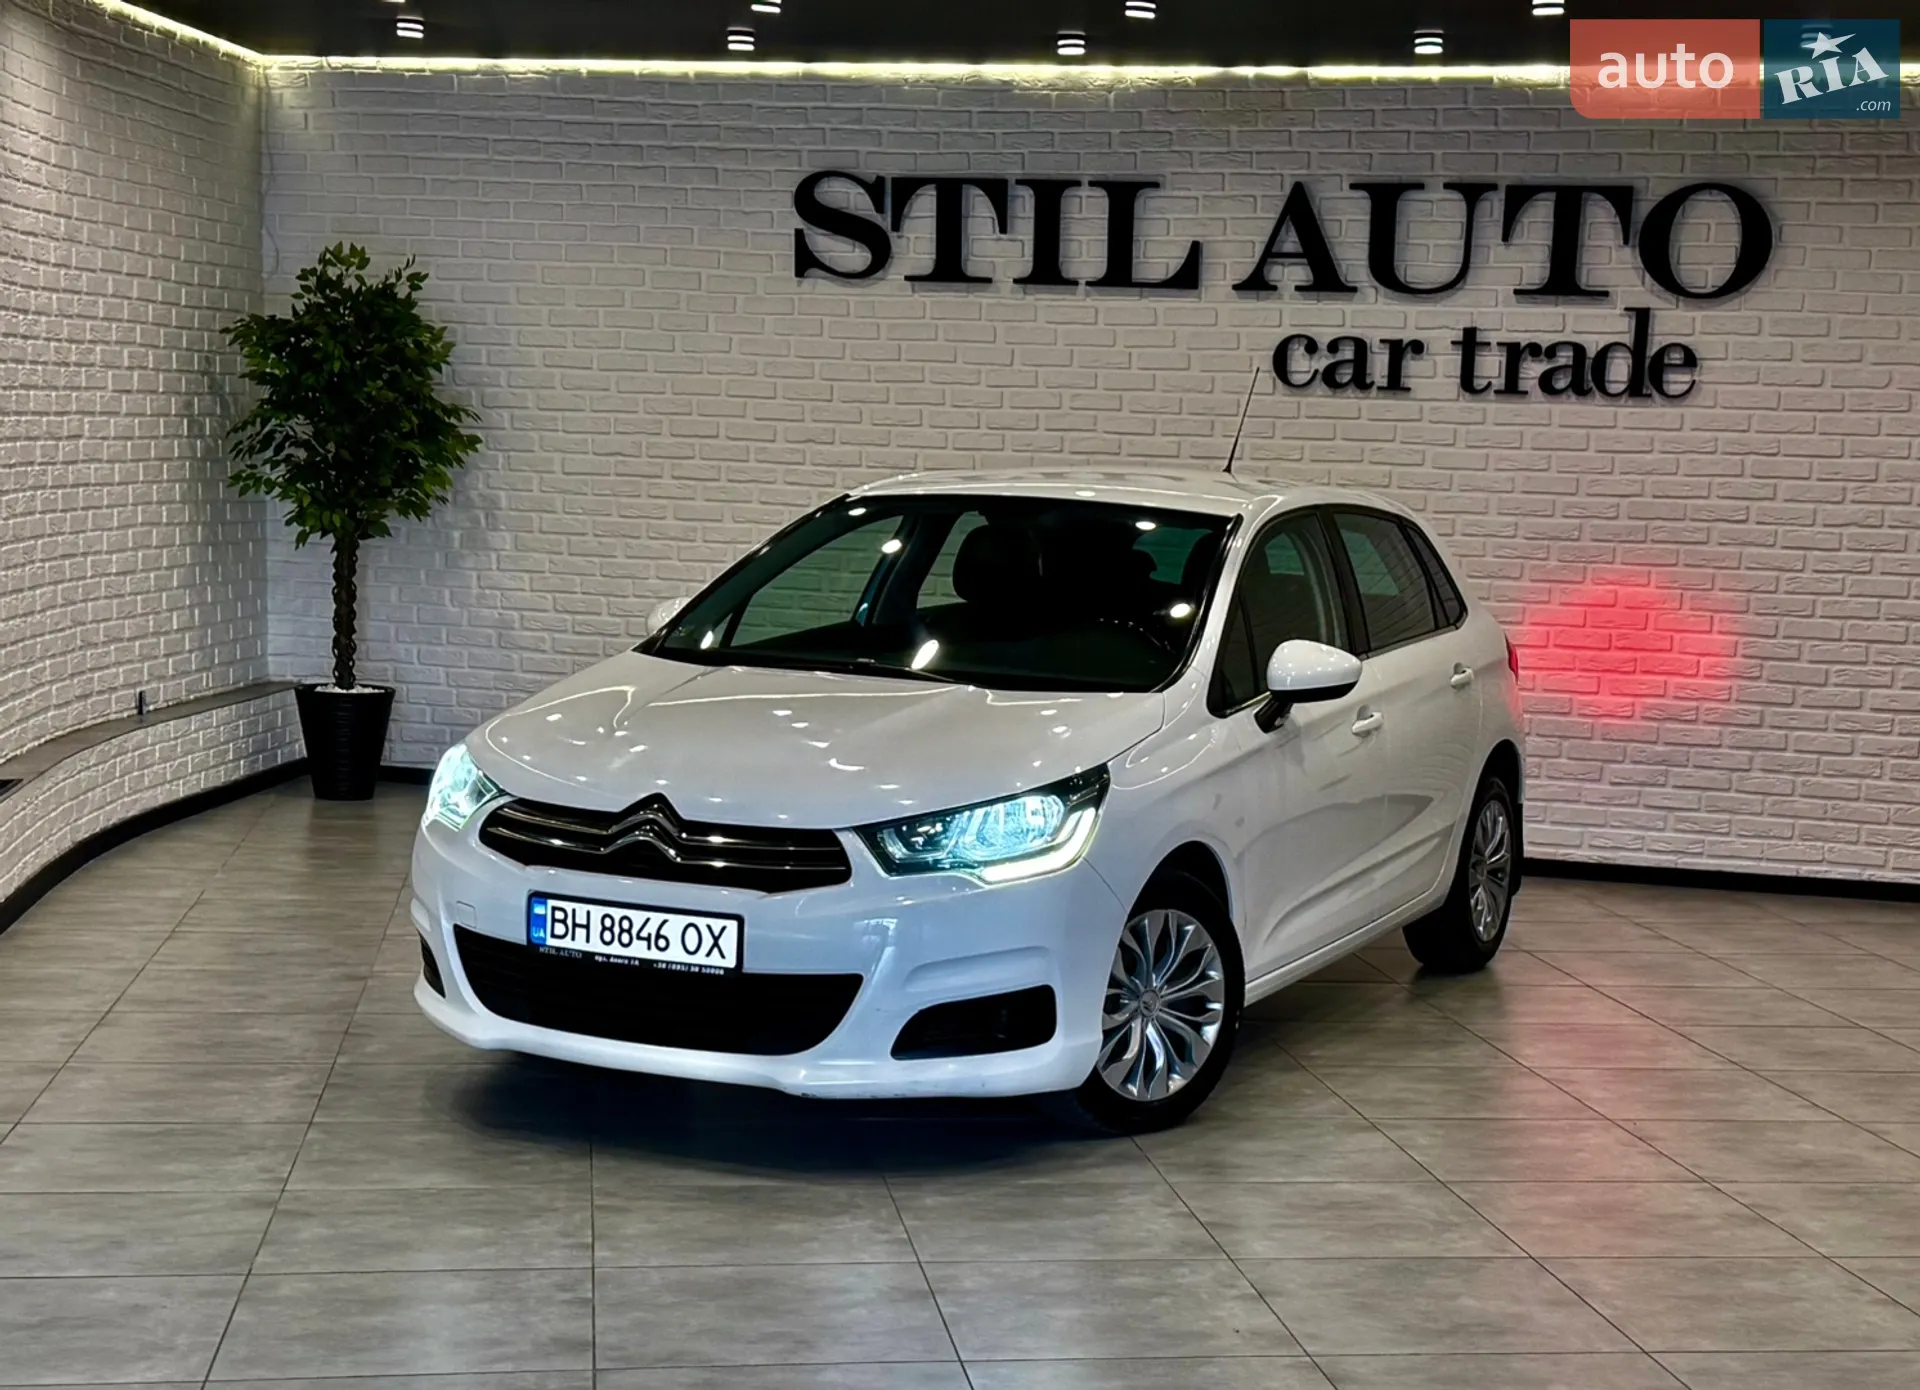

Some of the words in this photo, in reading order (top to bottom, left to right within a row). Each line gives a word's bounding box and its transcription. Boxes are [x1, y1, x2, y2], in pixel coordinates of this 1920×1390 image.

[793, 169, 1202, 291] STIL
[1231, 181, 1775, 300] AUTO
[1271, 332, 1426, 394] car
[1450, 307, 1698, 400] trade
[532, 926, 546, 938] UA
[550, 905, 591, 944] BH
[599, 913, 670, 952] 8846
[681, 922, 727, 960] OX
